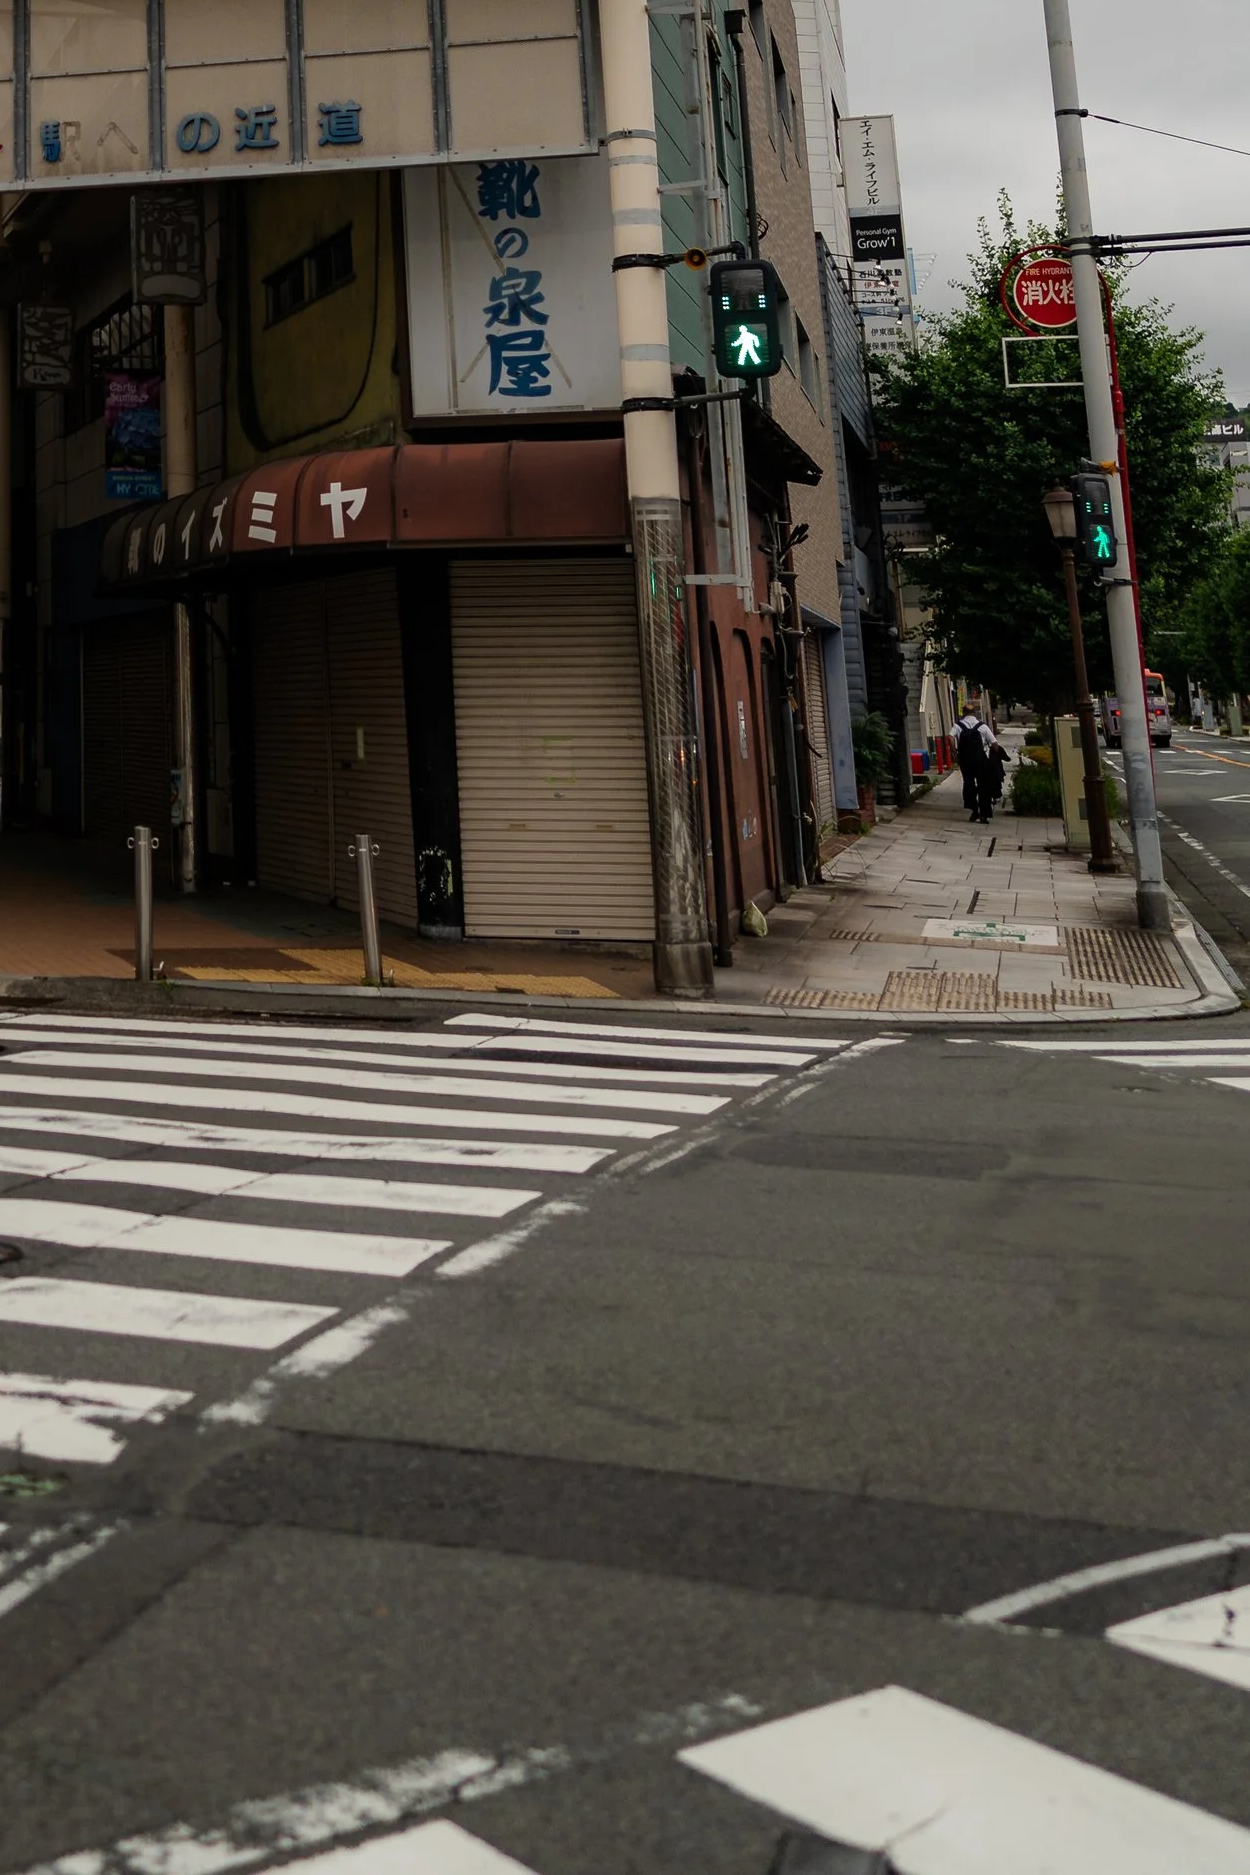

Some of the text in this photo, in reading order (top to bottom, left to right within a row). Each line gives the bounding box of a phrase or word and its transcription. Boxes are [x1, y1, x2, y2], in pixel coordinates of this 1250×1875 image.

[477, 160, 553, 398] 靴の泉屋
[1025, 268, 1040, 276] FIRE
